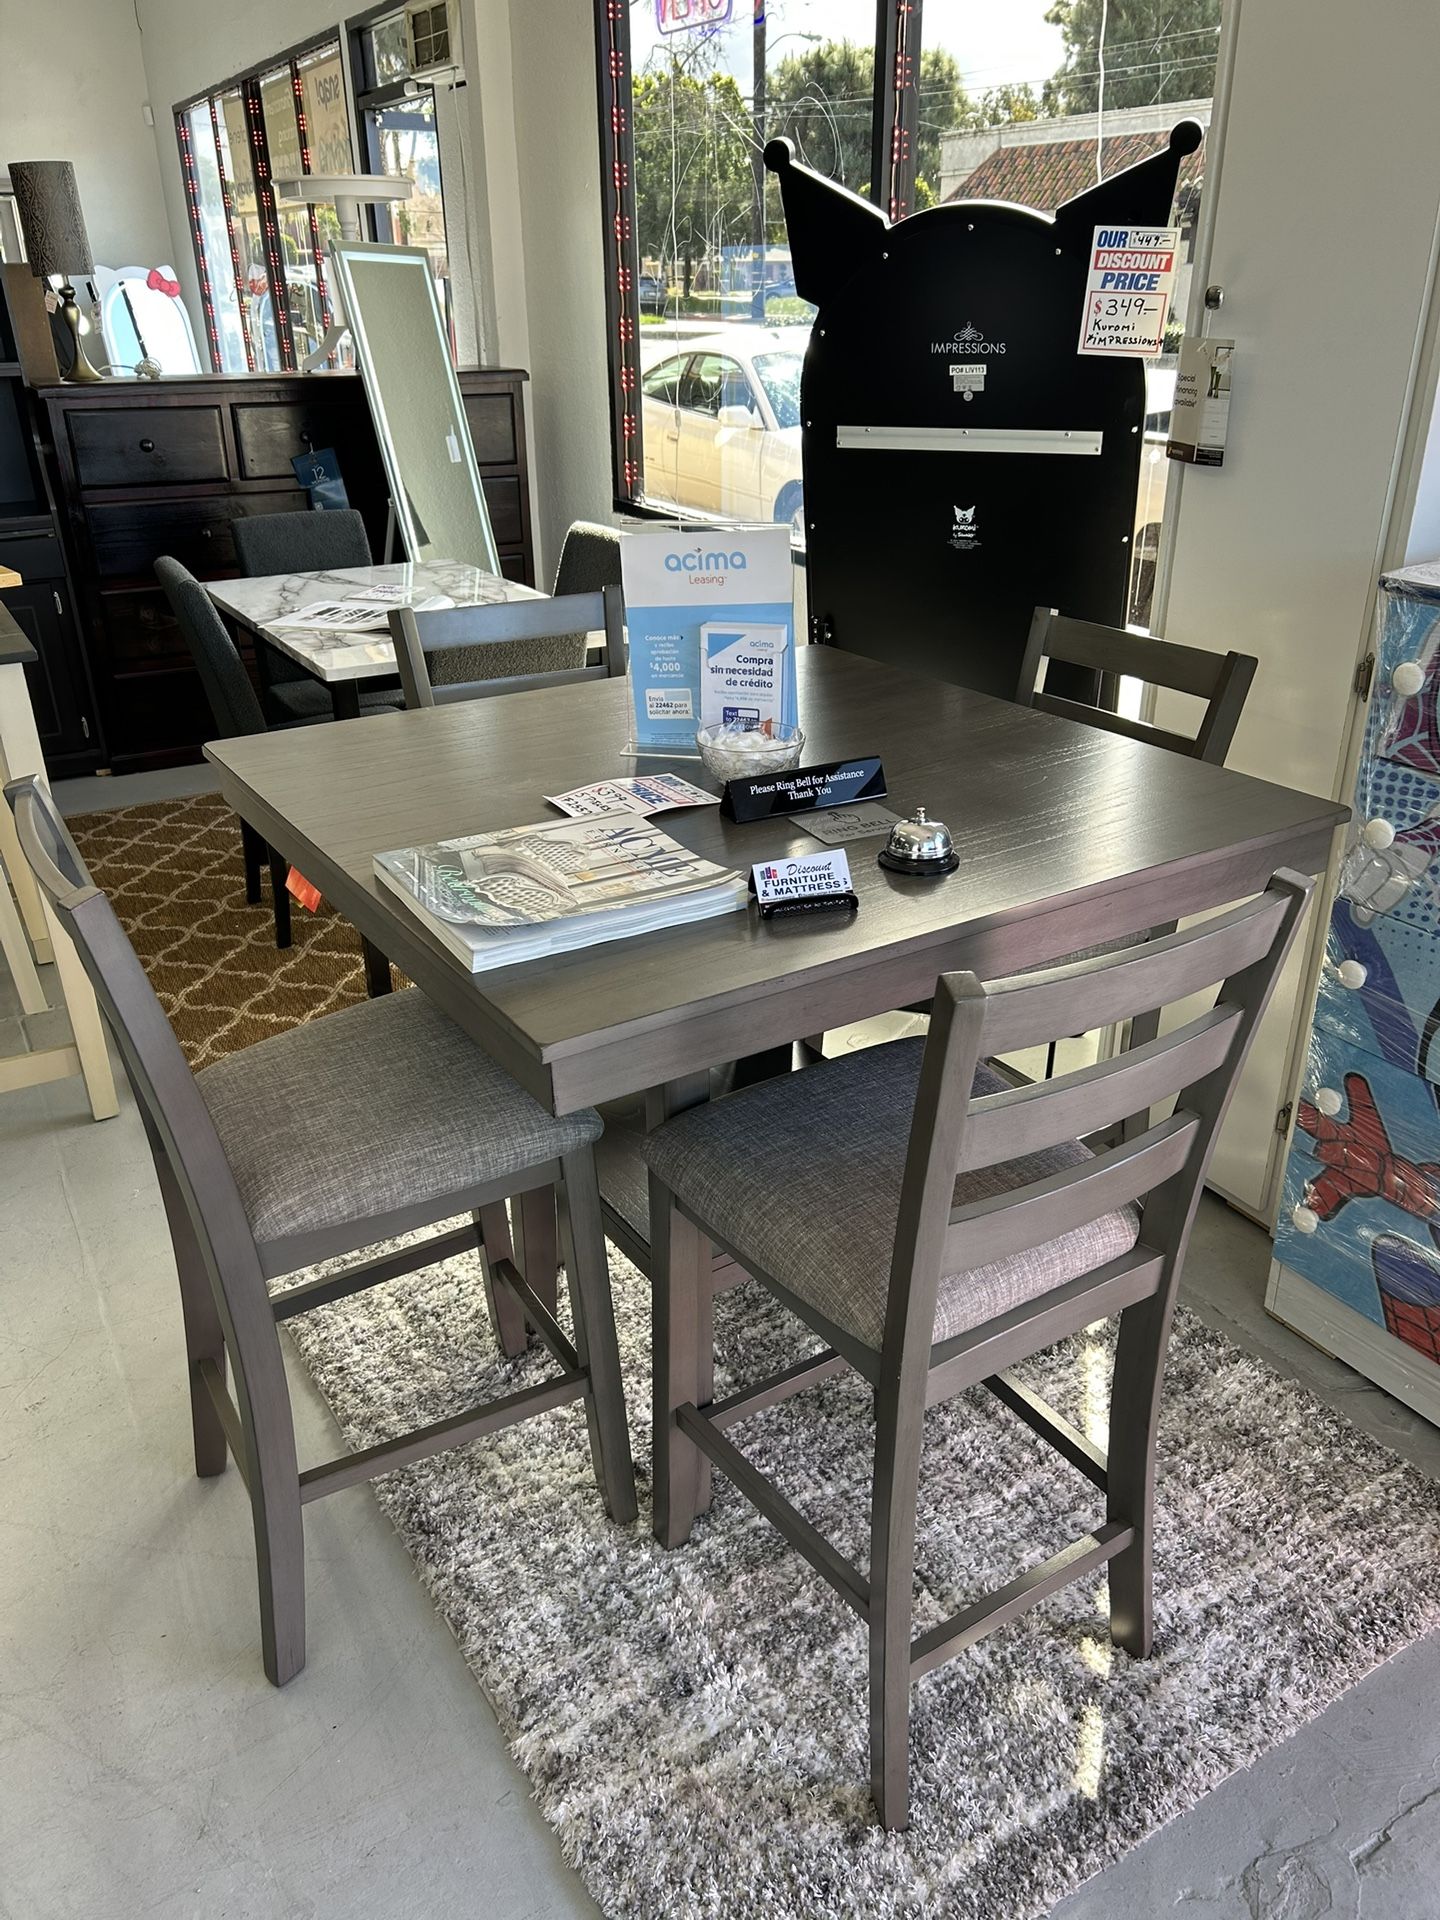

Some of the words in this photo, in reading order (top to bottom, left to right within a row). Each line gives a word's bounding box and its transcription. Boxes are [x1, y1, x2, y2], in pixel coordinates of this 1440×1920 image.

[1096, 230, 1129, 248] OUR
[1097, 252, 1171, 270] DISCOUNT
[1100, 272, 1161, 291] PRICE
[1092, 318, 1136, 331] Kuromi
[930, 342, 1007, 355] IMPRESSIONS
[311, 466, 325, 481] 12
[664, 549, 747, 572] acima
[689, 575, 725, 586] Leasing
[644, 634, 667, 642] Conoce
[749, 639, 774, 649] acima
[650, 662, 681, 673] $4,000
[736, 654, 774, 667] Compra
[710, 664, 724, 674] sin
[725, 666, 773, 677] necesidad
[725, 677, 737, 687] de
[740, 678, 773, 688] crédito
[750, 784, 776, 795] Please
[776, 780, 796, 791] Ring
[796, 776, 811, 787] Bell
[812, 775, 824, 785] for
[824, 768, 865, 783] Assistance
[788, 788, 814, 801] Thank
[816, 785, 832, 796] You
[822, 824, 858, 837] RING
[860, 818, 896, 829] BELL
[598, 827, 701, 878] ACME
[786, 861, 832, 876] Discount
[764, 872, 836, 888] FURNITURE
[761, 889, 770, 898] &
[774, 880, 841, 896] MATTRESS
